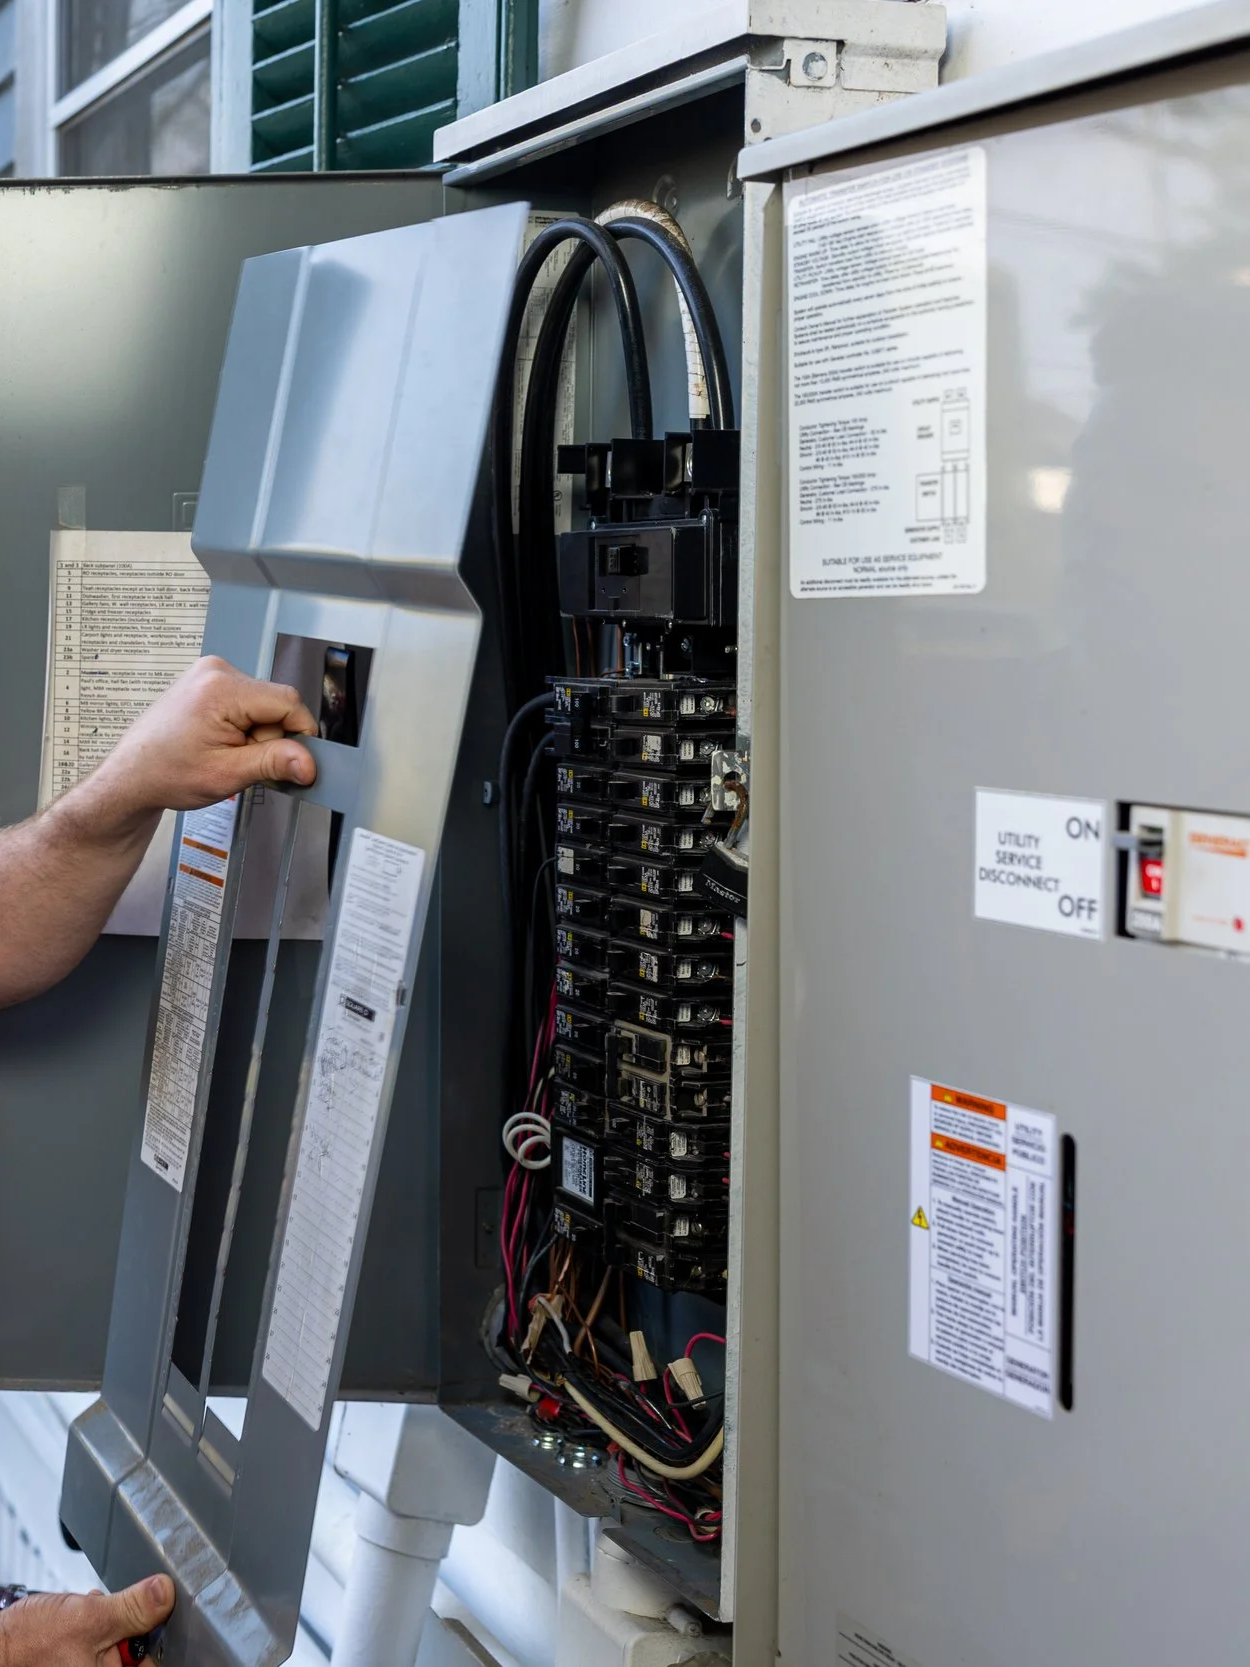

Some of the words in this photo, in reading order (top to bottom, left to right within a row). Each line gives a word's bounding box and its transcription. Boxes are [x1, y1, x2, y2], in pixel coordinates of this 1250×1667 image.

[848, 556, 860, 566] FOR
[1066, 816, 1100, 841] ON
[998, 831, 1040, 850] UTILITY
[995, 850, 1042, 870] SERVICE
[978, 866, 1060, 892] DISCONNECT
[1058, 894, 1098, 921] OFF
